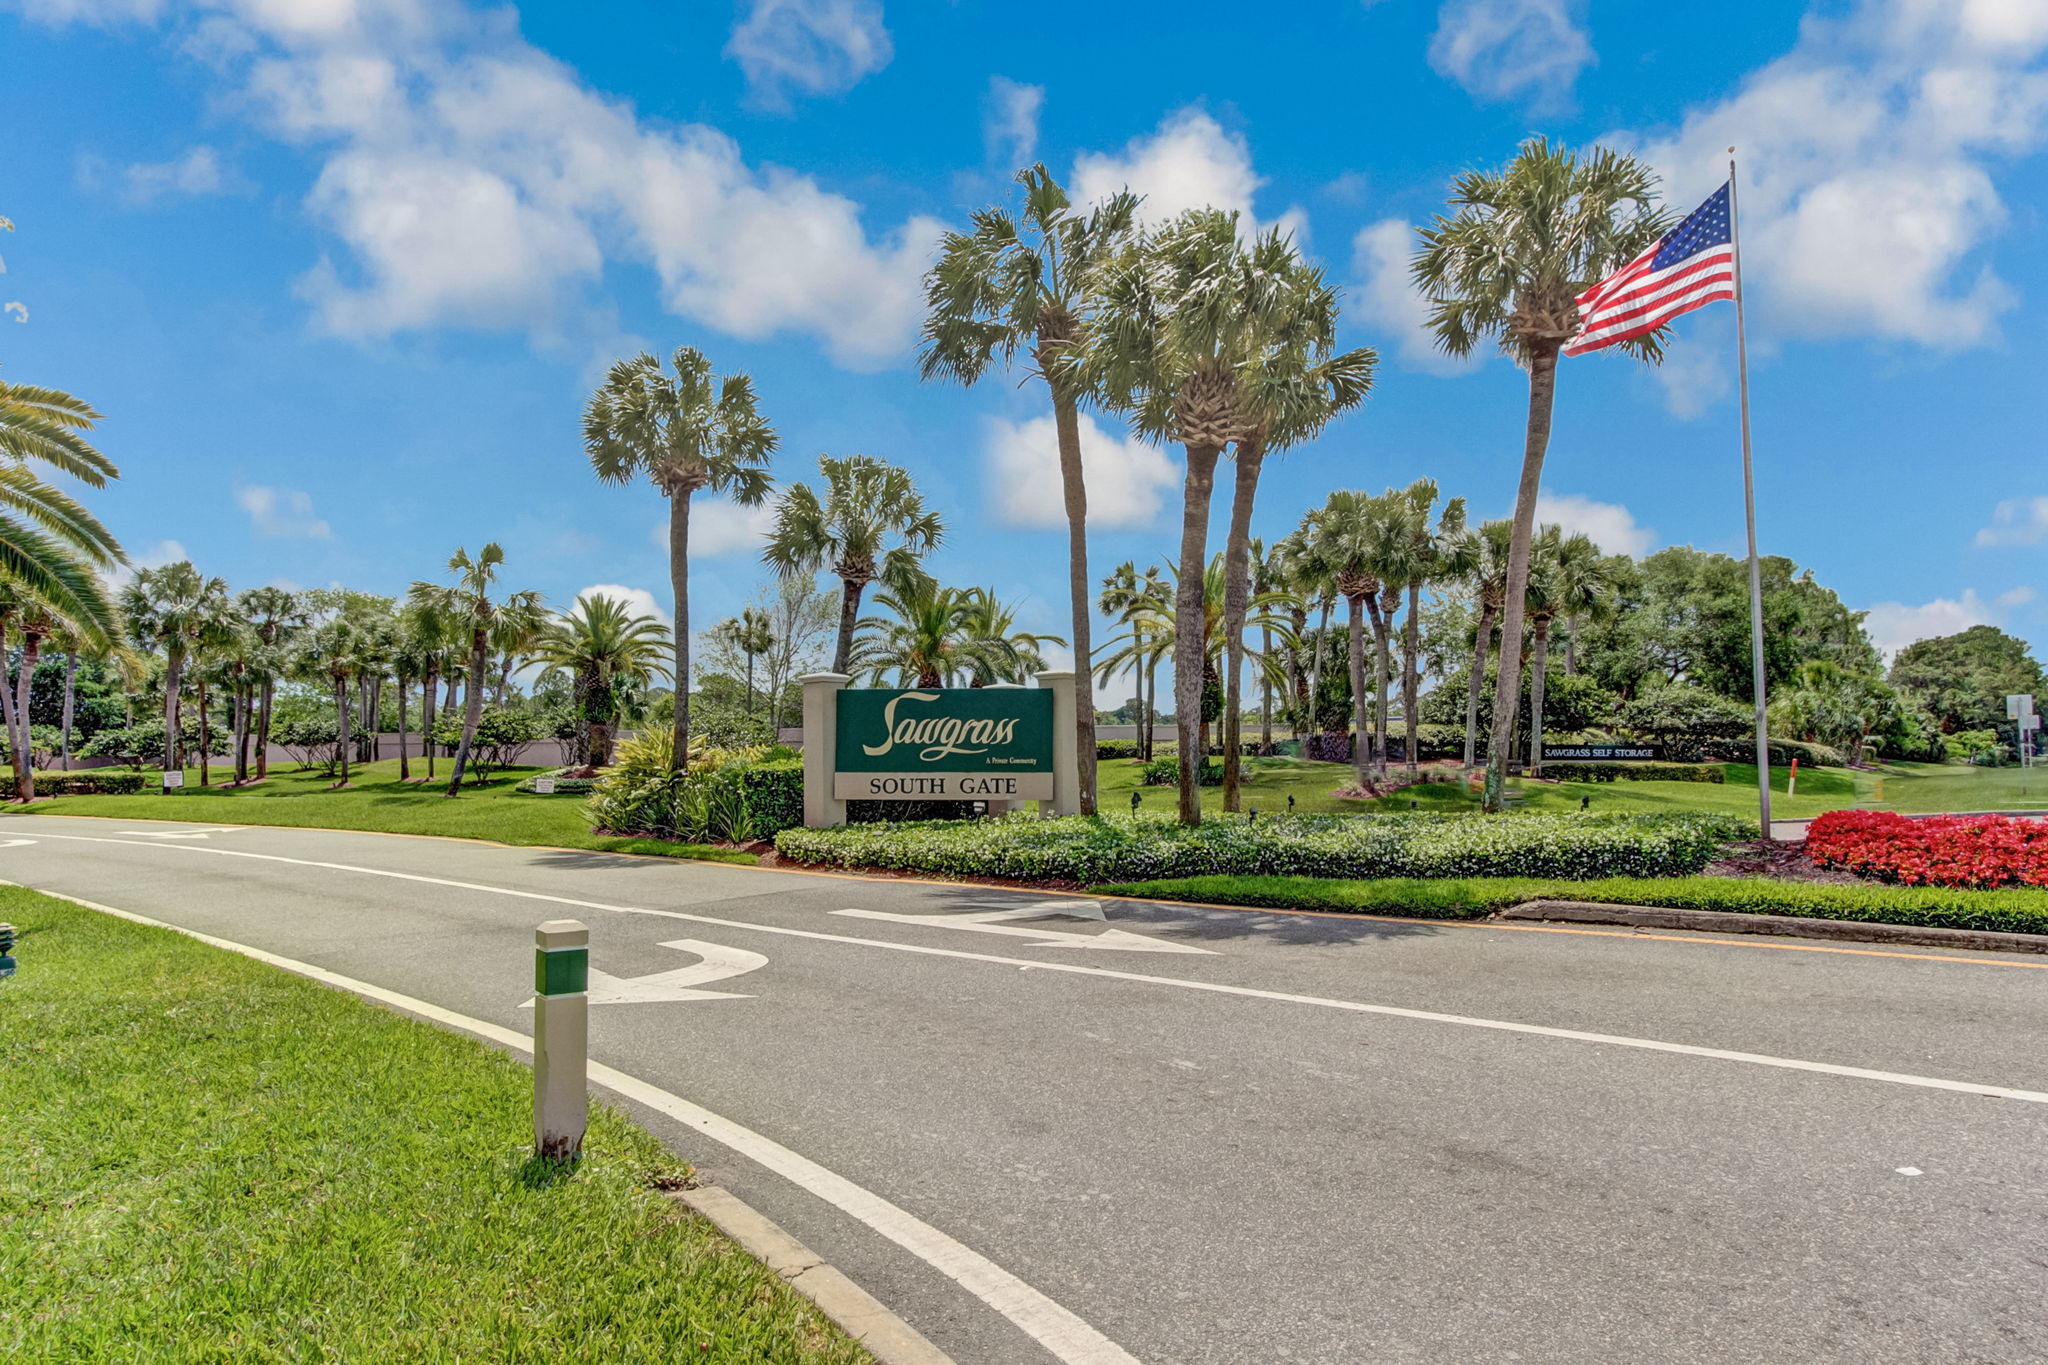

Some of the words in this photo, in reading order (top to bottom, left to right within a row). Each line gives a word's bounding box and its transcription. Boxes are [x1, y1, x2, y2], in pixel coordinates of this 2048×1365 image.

[862, 691, 1021, 762] Sawgrass
[1545, 749, 1591, 757] SAWGRASS
[1592, 749, 1612, 757] SELF
[1615, 749, 1653, 757] STORAGE
[870, 778, 946, 794] SOUTH
[959, 778, 1017, 794] GATE
